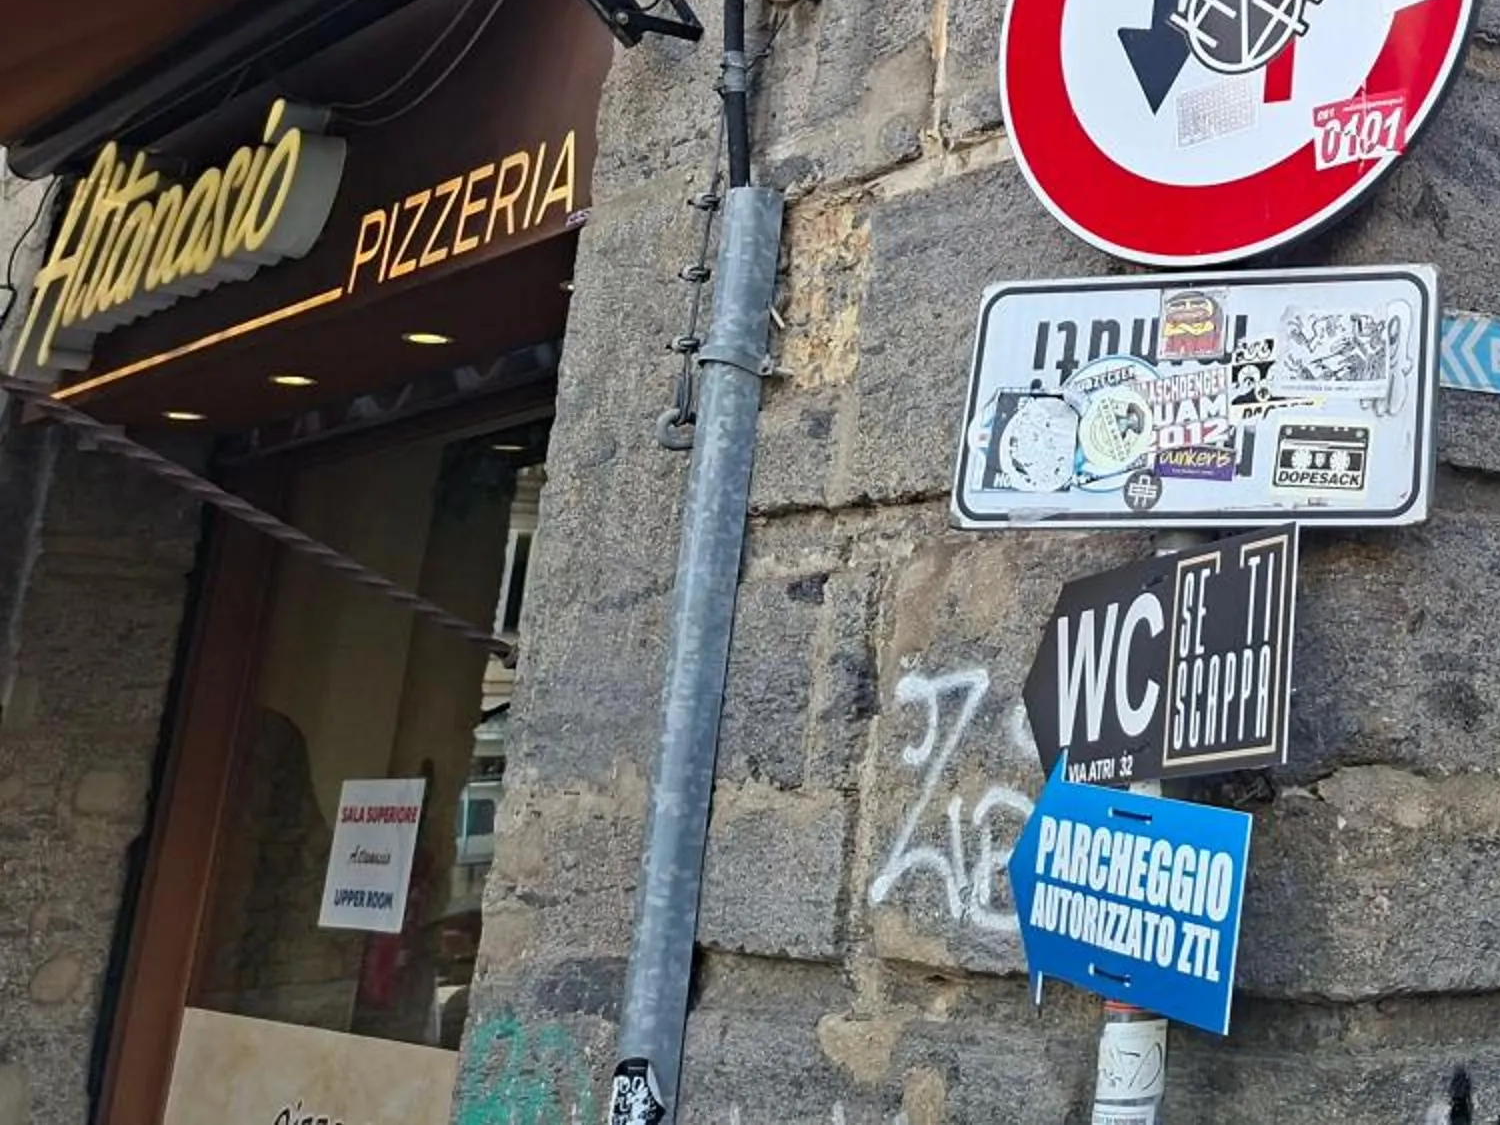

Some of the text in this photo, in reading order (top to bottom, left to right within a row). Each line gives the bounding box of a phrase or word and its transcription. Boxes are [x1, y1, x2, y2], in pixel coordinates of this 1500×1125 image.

[347, 129, 576, 294] PIZZERIA
[1278, 470, 1361, 487] DOPESACK
[1179, 552, 1276, 658] SE TI
[1057, 592, 1165, 748] WC
[1173, 644, 1271, 751] SCAPPA
[341, 804, 418, 824] SALA SUPERIORE
[1068, 754, 1133, 783] VIA ATRI 32
[333, 888, 394, 910] UPPER ROOM
[1035, 815, 1234, 923] PARCHEGGIO
[1030, 882, 1221, 983] AUTORIZZATO ZTL
